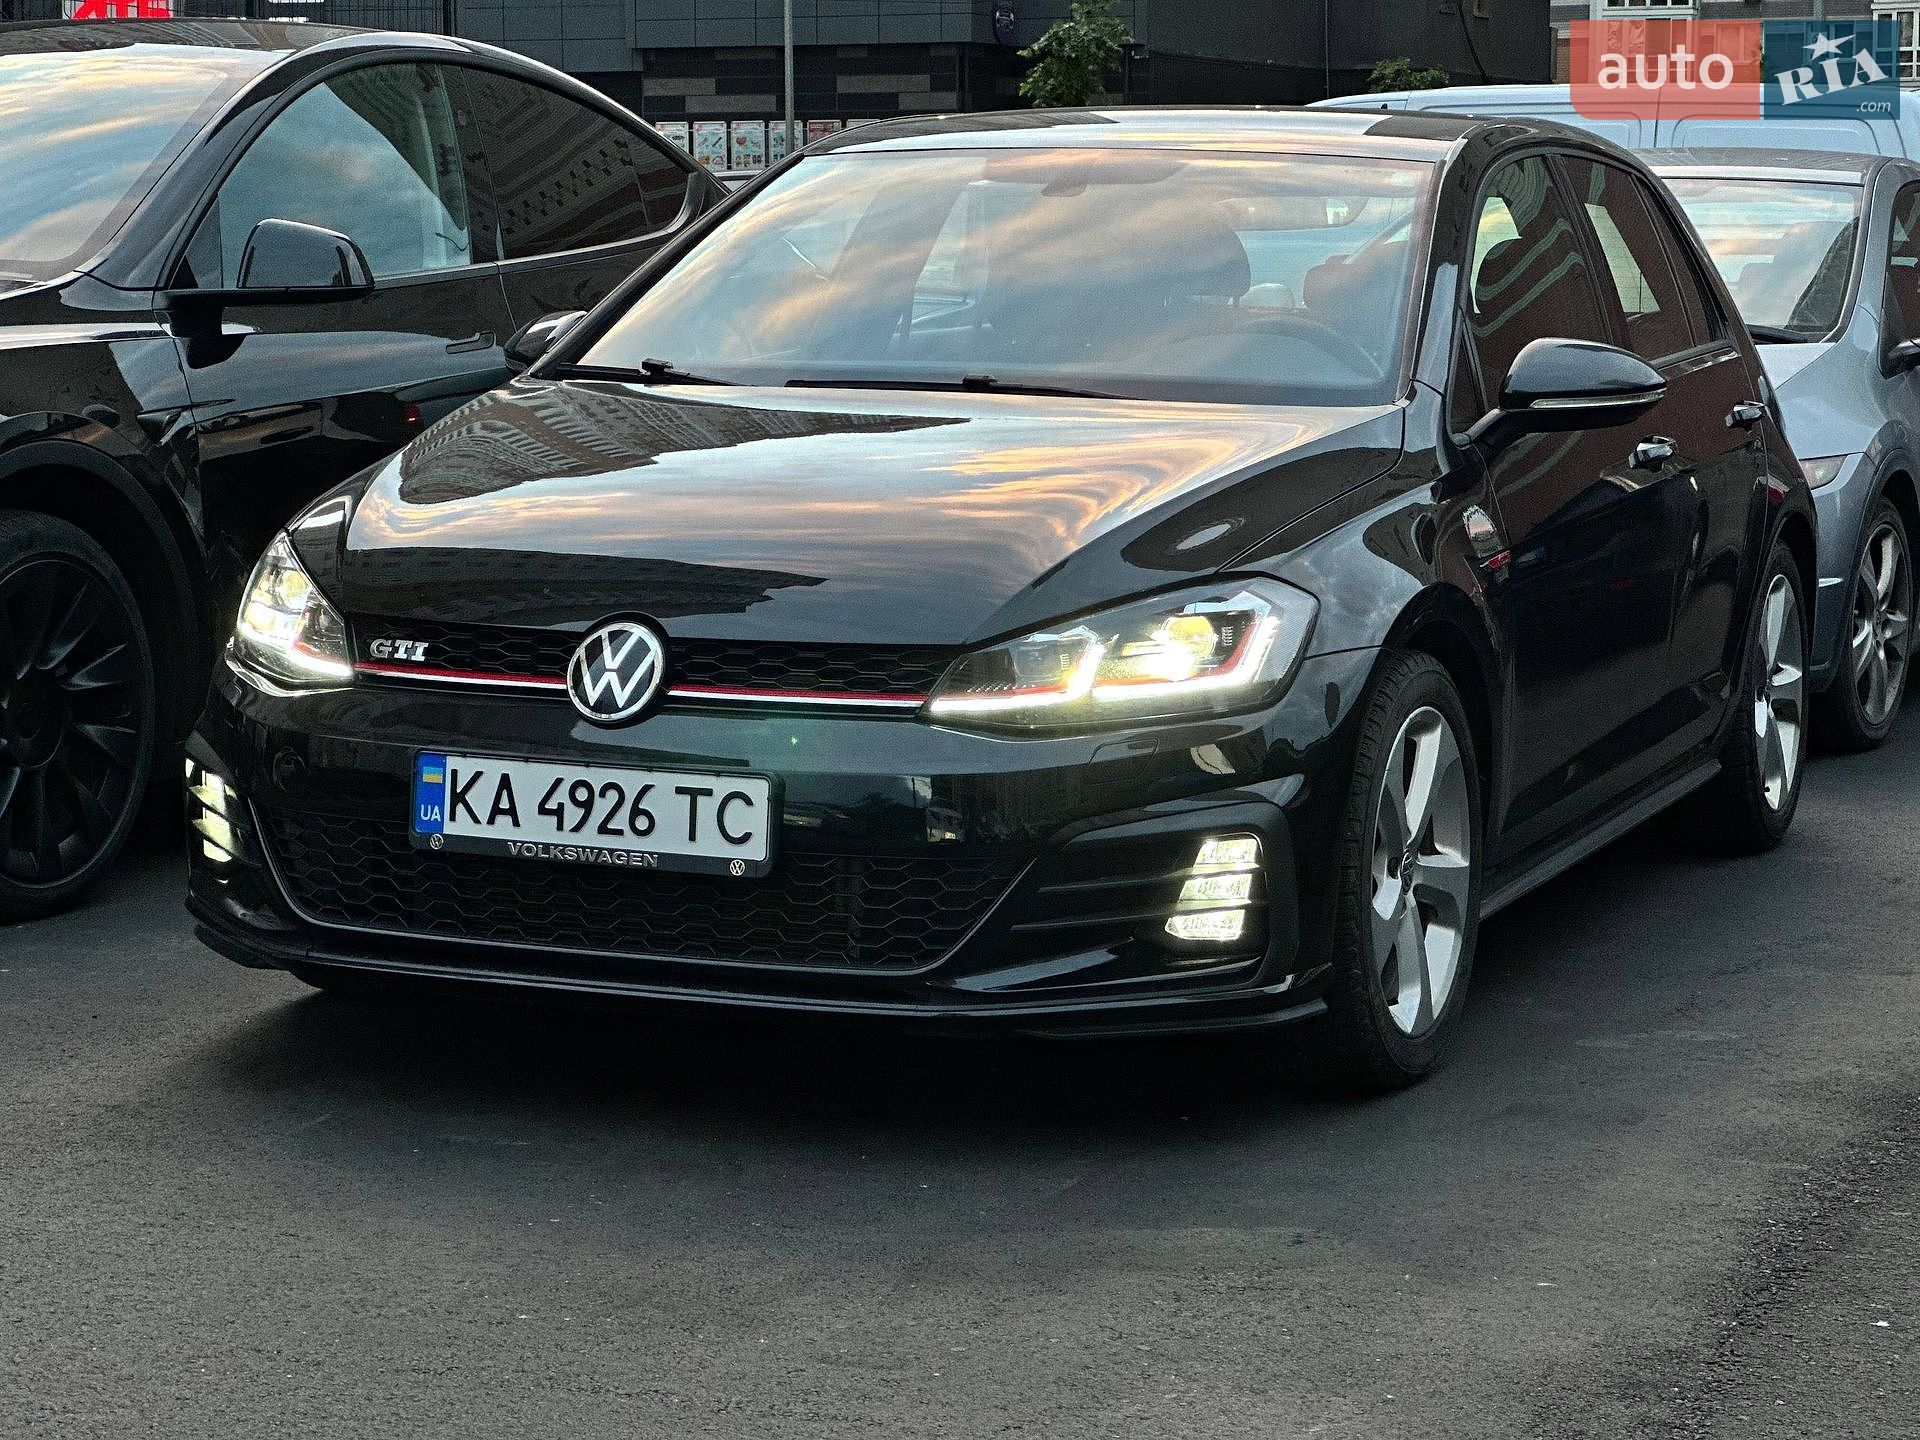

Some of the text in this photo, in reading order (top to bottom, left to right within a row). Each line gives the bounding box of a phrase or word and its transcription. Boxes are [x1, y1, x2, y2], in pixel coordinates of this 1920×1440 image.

[369, 638, 429, 662] GTI
[420, 803, 442, 823] UA
[448, 768, 754, 846] KA 4926 TC
[507, 841, 658, 869] VOLKSWAGEN
